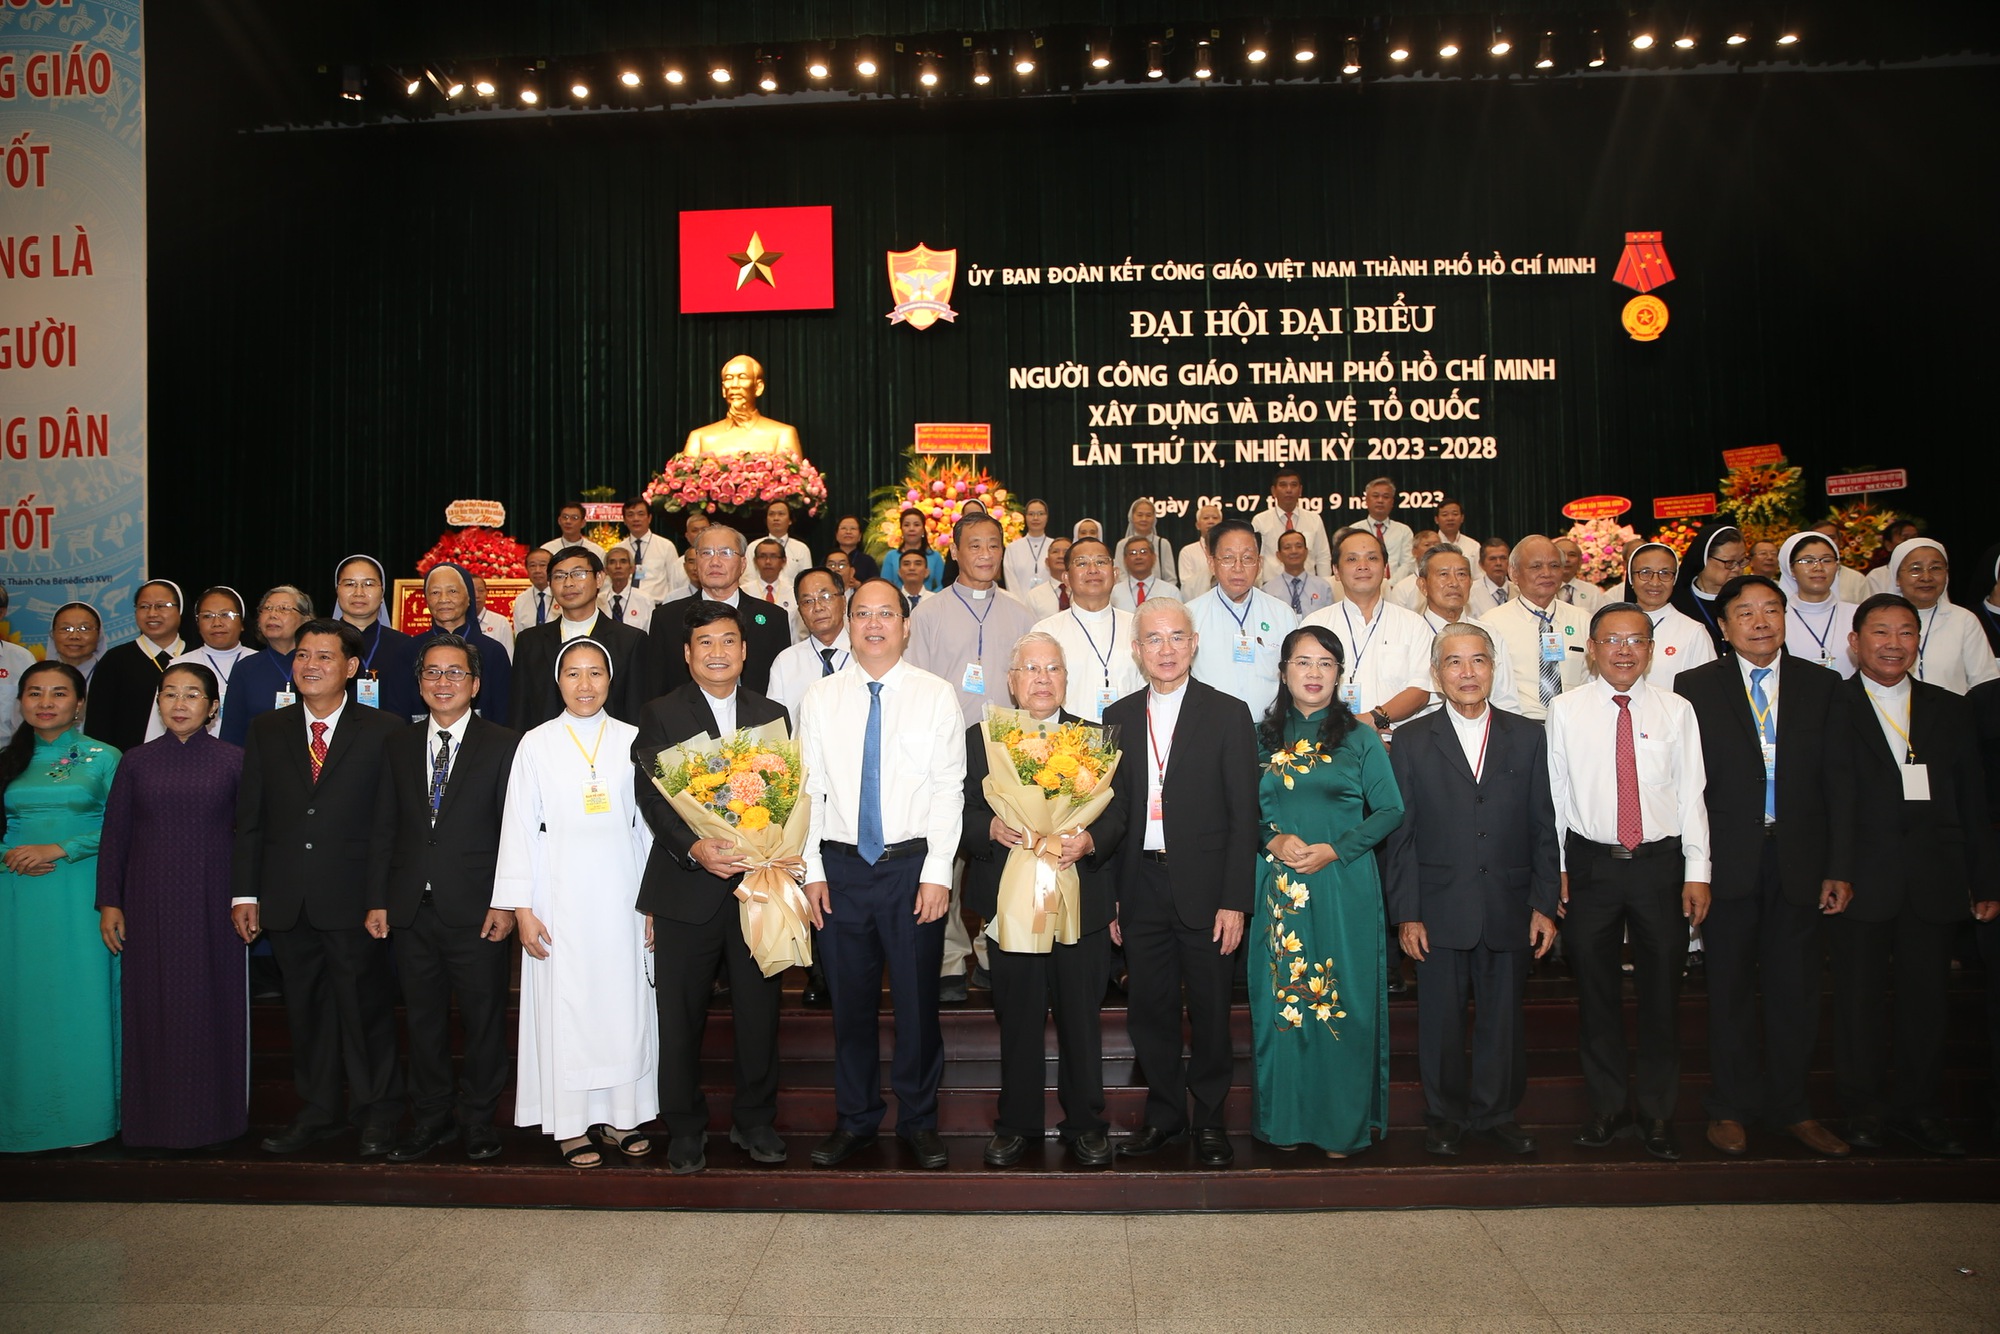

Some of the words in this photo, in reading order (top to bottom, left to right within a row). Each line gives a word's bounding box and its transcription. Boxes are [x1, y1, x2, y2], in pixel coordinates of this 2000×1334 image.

[26, 43, 111, 98] GIÁO
[53, 225, 93, 277] LÀ
[968, 263, 994, 287] ỦY
[1003, 268, 1040, 285] BAN
[1047, 262, 1103, 284] ĐOÀN
[1110, 256, 1145, 282] KẾT
[1151, 260, 1205, 281] CÔNG
[1212, 258, 1258, 280] GIÁO
[1265, 258, 1305, 283] VIỆT
[1312, 260, 1357, 278] NAM
[1363, 255, 1428, 277] THÀNH
[1434, 251, 1472, 276] PHỐ
[1478, 251, 1506, 276] HỒ
[1511, 254, 1542, 275] CHÍ
[1548, 257, 1596, 275] MINH
[1130, 310, 1194, 344] ĐẠI
[1204, 302, 1269, 344] HỘI
[1279, 308, 1343, 341] ĐẠI
[1354, 292, 1436, 334] BIỂU
[1009, 361, 1089, 389] NGƯỜI
[1098, 360, 1168, 387] CÔNG
[1178, 358, 1239, 386] GIÁO
[1248, 357, 1334, 384] THÀNH
[1343, 351, 1394, 383] PHỐ
[1402, 350, 1437, 382] HỒ
[1445, 354, 1486, 381] CHÍ
[1494, 359, 1556, 380] MINH
[1088, 400, 1137, 427] XÂY
[1147, 399, 1219, 430] DỰNG
[1227, 397, 1259, 424] VÀ
[1268, 394, 1318, 423] BẢO
[1325, 395, 1357, 427] VỆ
[1369, 387, 1403, 422] TỔ
[1410, 389, 1480, 423] QUỐC
[39, 407, 108, 459] DÂN
[1072, 433, 1121, 467] LẦN
[1132, 435, 1185, 465] THỨ
[1193, 441, 1225, 468] IX,
[1235, 434, 1311, 468] NHIỆM
[1321, 433, 1355, 462] KỲ
[1329, 493, 1342, 509] 9
[1398, 491, 1444, 509] 2023
[35, 577, 51, 586] Cha
